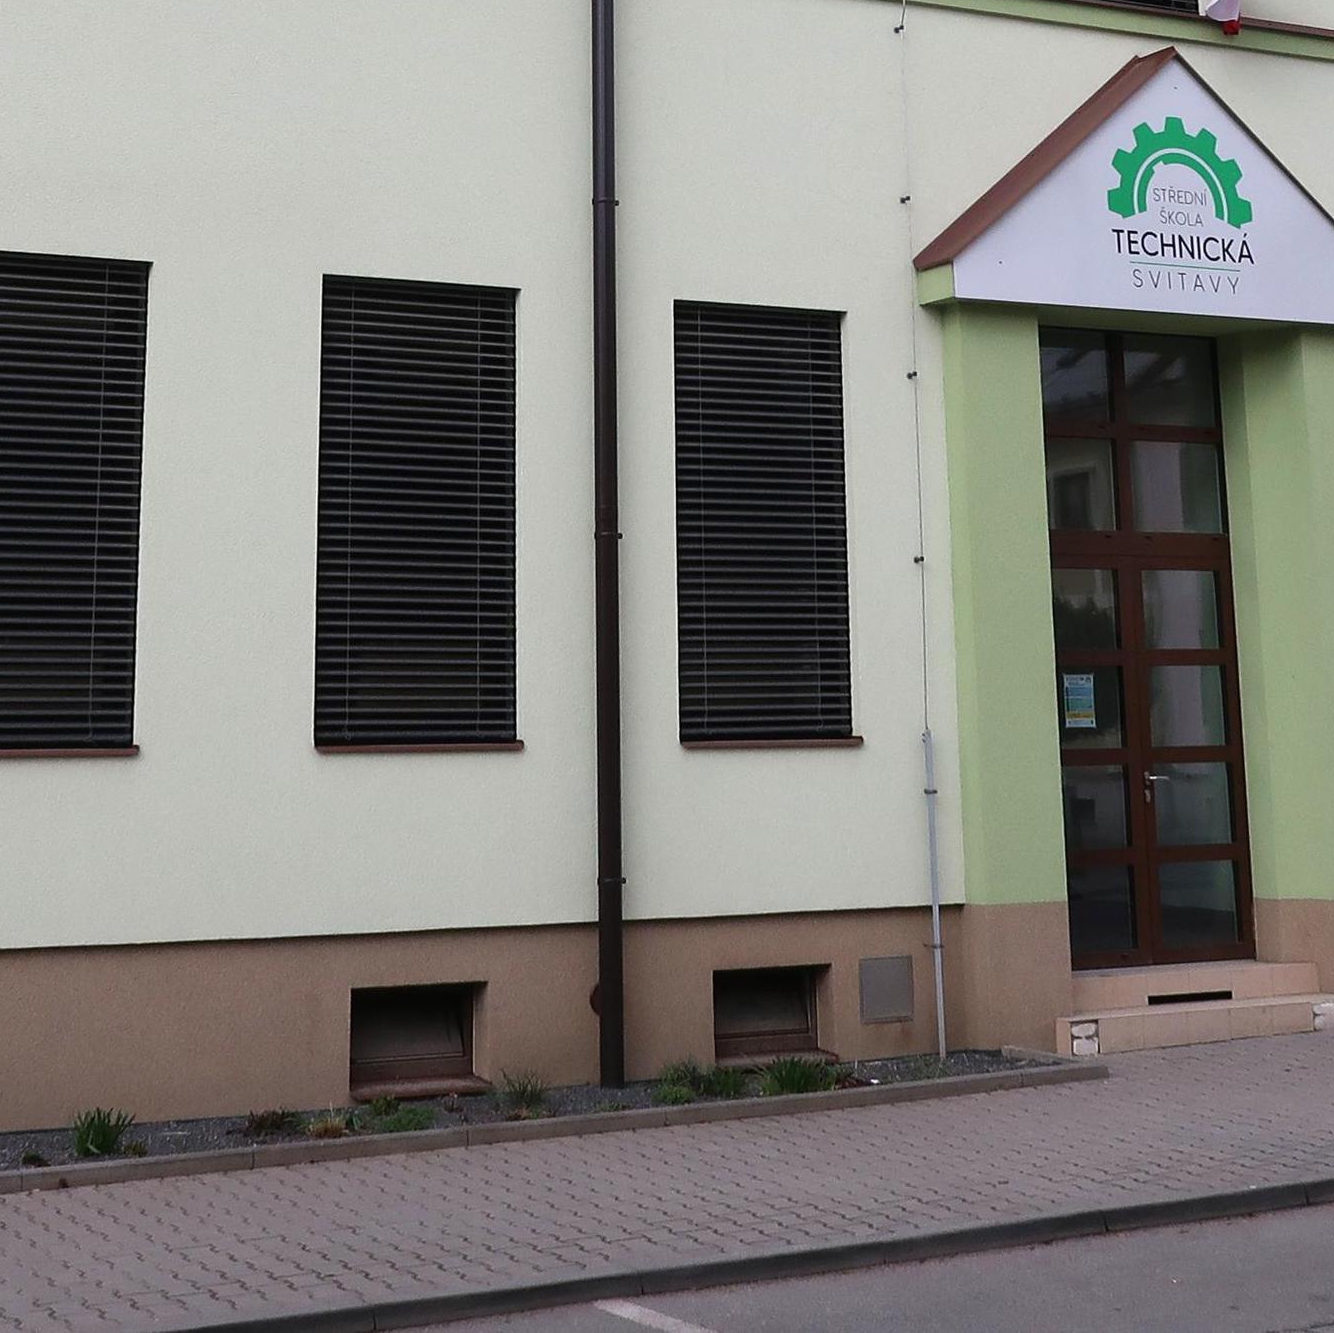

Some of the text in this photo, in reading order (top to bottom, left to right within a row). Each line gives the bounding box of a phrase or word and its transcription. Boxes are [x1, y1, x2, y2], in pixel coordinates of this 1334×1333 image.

[1153, 186, 1207, 206] STŘEDNÍ
[1159, 209, 1204, 227] ŠKOLA
[1111, 228, 1254, 264] TECHNICKÁ
[1132, 269, 1240, 295] SVITAVY
